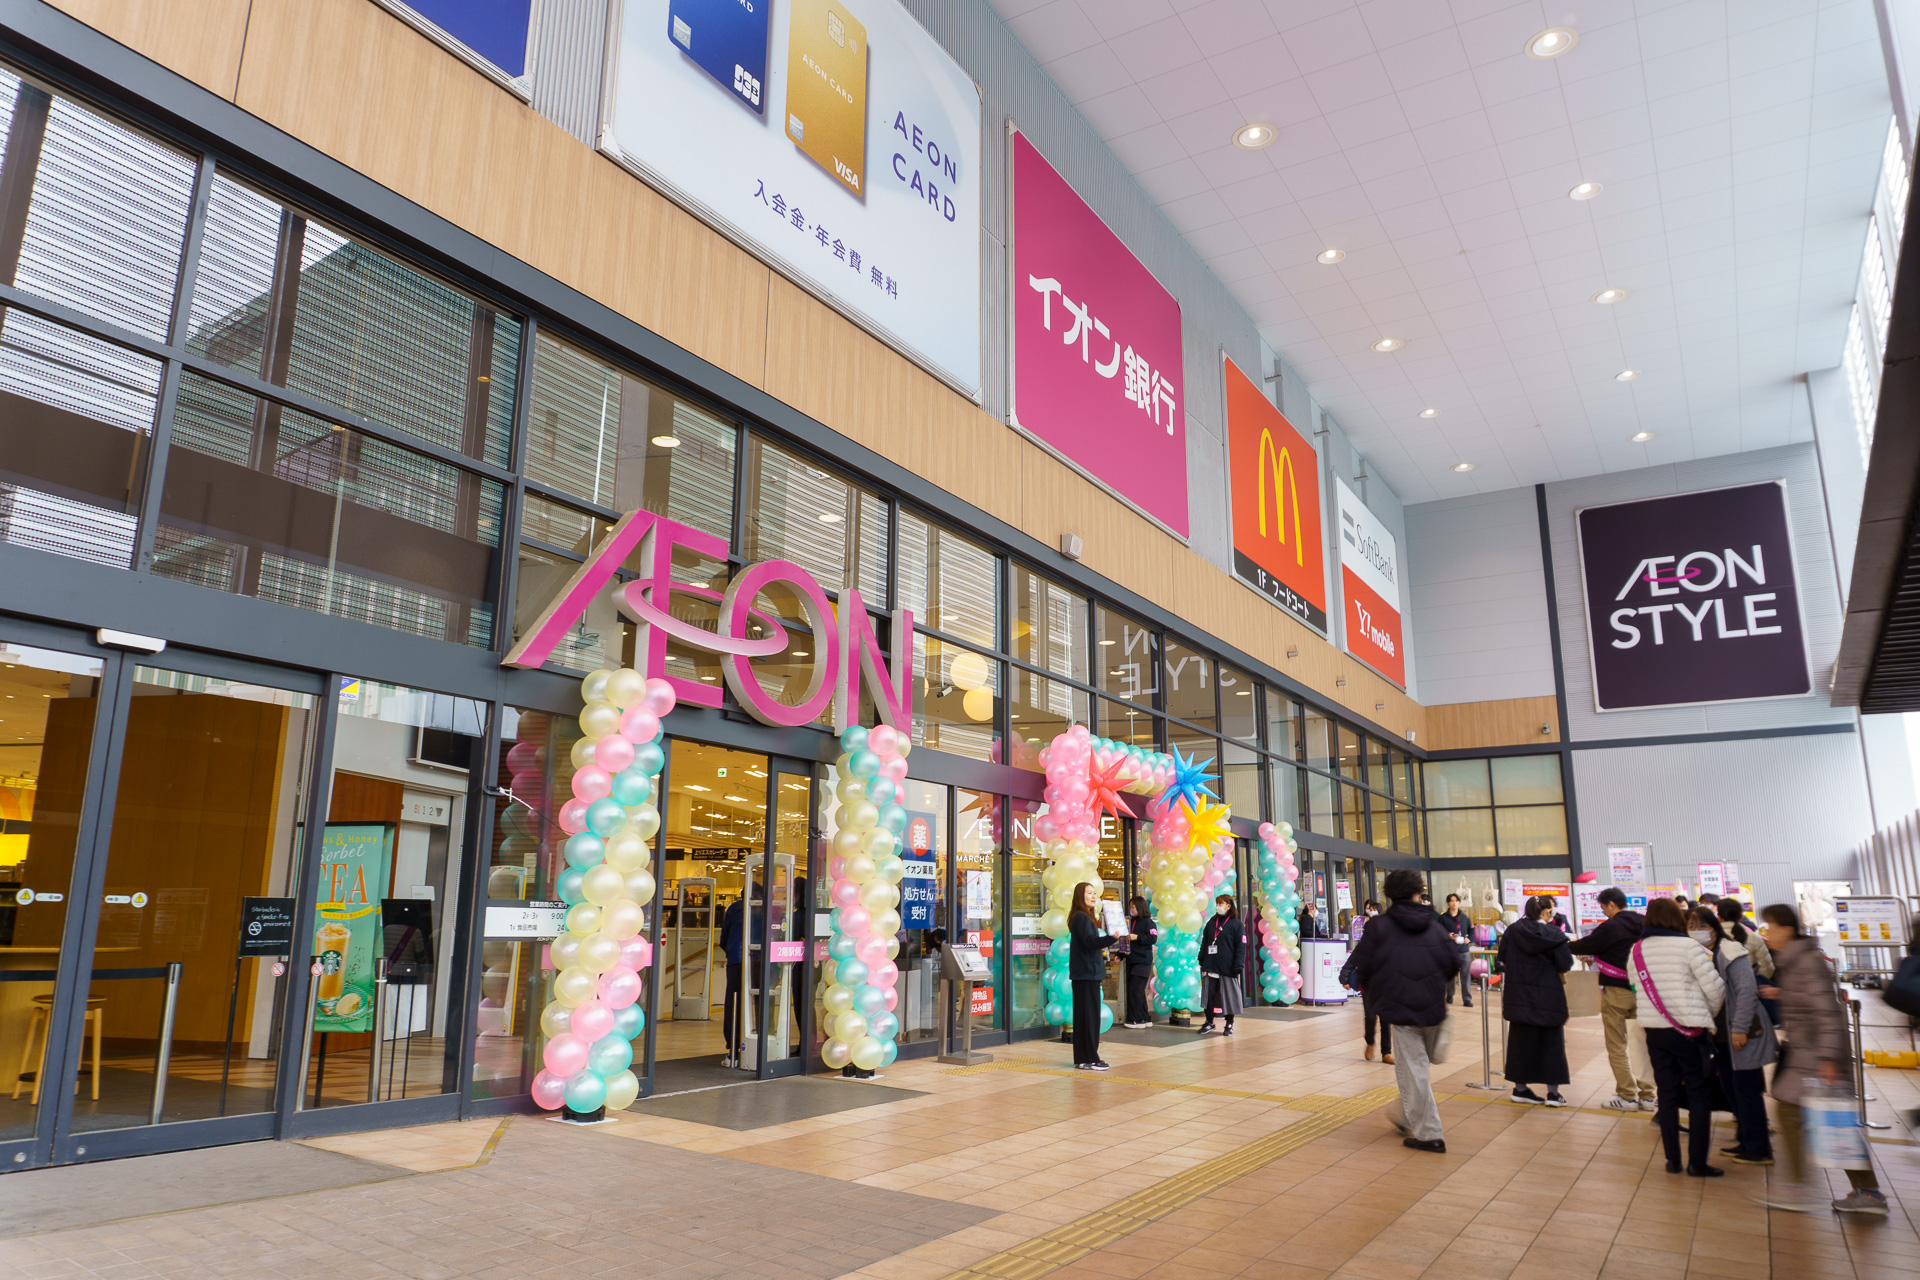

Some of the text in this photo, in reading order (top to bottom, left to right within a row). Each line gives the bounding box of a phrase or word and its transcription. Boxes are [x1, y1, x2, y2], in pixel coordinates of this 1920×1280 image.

[734, 74, 759, 98] JCB
[803, 54, 853, 104] AEON CARD
[893, 110, 956, 184] AEON
[832, 155, 859, 190] VISA
[892, 152, 956, 222] CARD
[753, 178, 898, 300] 入会金・年会費 無料
[1029, 273, 1177, 436] イオン銀行
[1356, 523, 1395, 585] SoftBank
[1257, 568, 1310, 620] 1F フードコート
[1609, 592, 1782, 649] STYLE
[348, 835, 378, 845] Honey
[912, 824, 926, 848] 薬
[905, 864, 935, 876] イオン薬局
[956, 854, 990, 864] MARCHÉ
[904, 887, 934, 901] 処方せん
[911, 905, 926, 920] 受付
